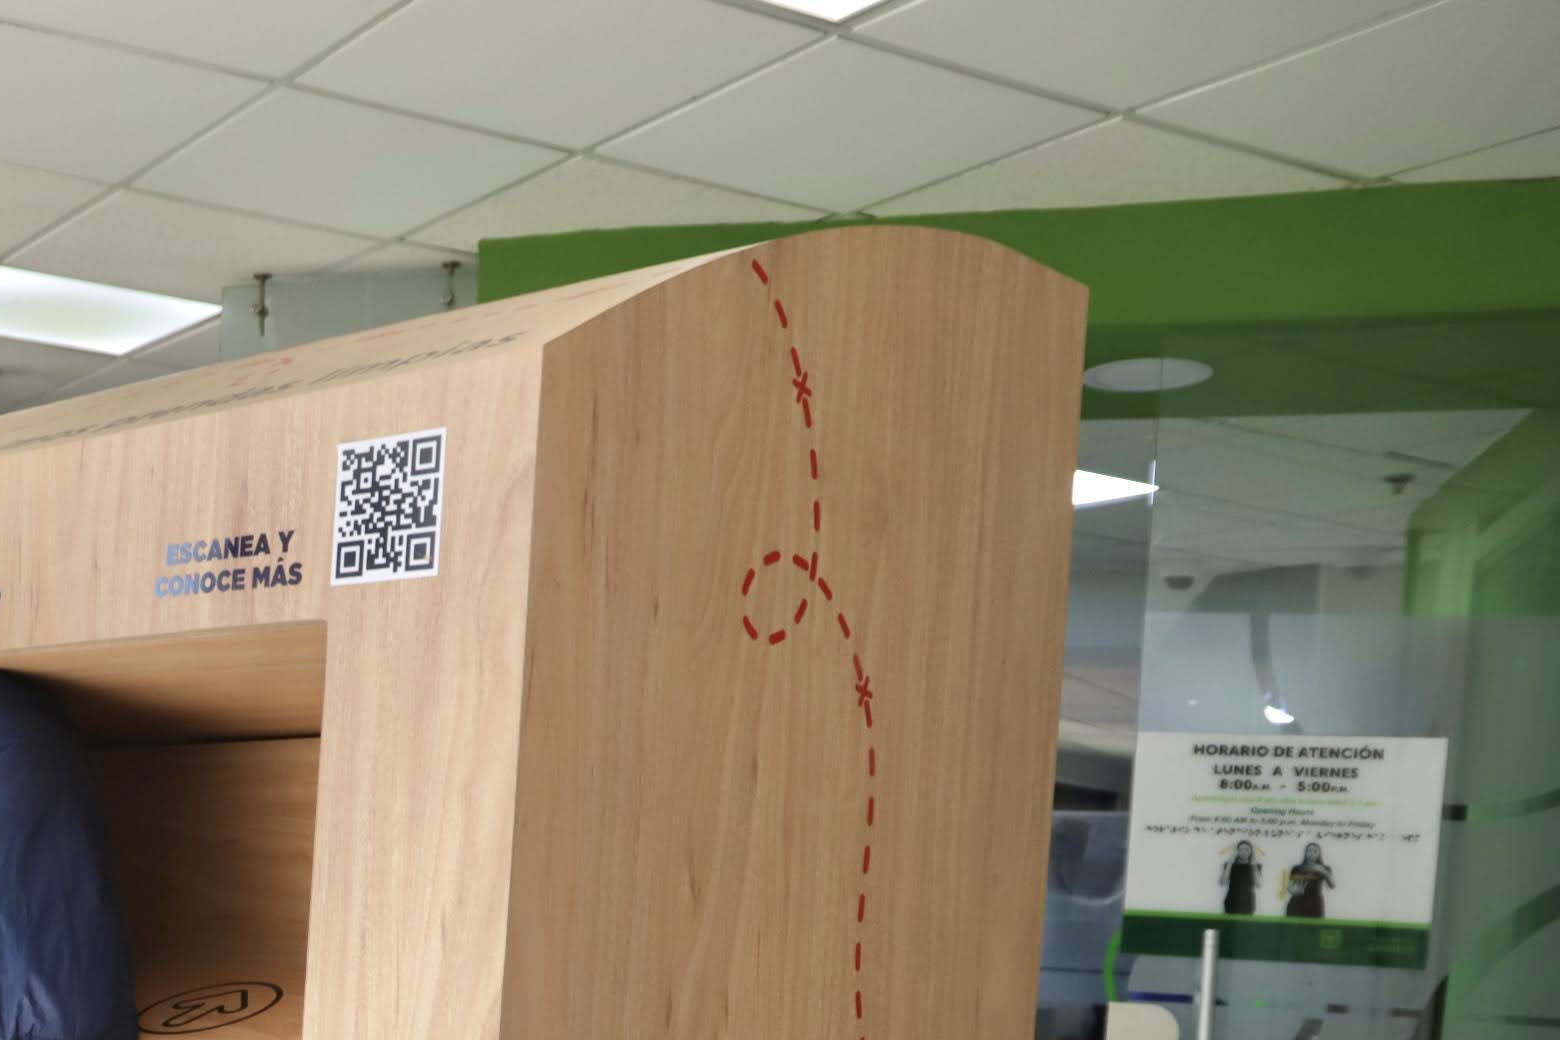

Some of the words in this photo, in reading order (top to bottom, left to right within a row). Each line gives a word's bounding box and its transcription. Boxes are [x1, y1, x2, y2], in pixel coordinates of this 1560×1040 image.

[166, 532, 271, 566] ESCANEA
[278, 530, 295, 553] Y
[154, 568, 246, 598] CONOCE
[252, 557, 303, 589] MÁS
[1193, 744, 1269, 758] HORARIO
[1273, 746, 1294, 758] DE
[1298, 745, 1385, 760] ATENCIÓN
[1213, 764, 1262, 777] LUNES
[1272, 765, 1283, 776] A
[1294, 766, 1359, 779] VIERNES
